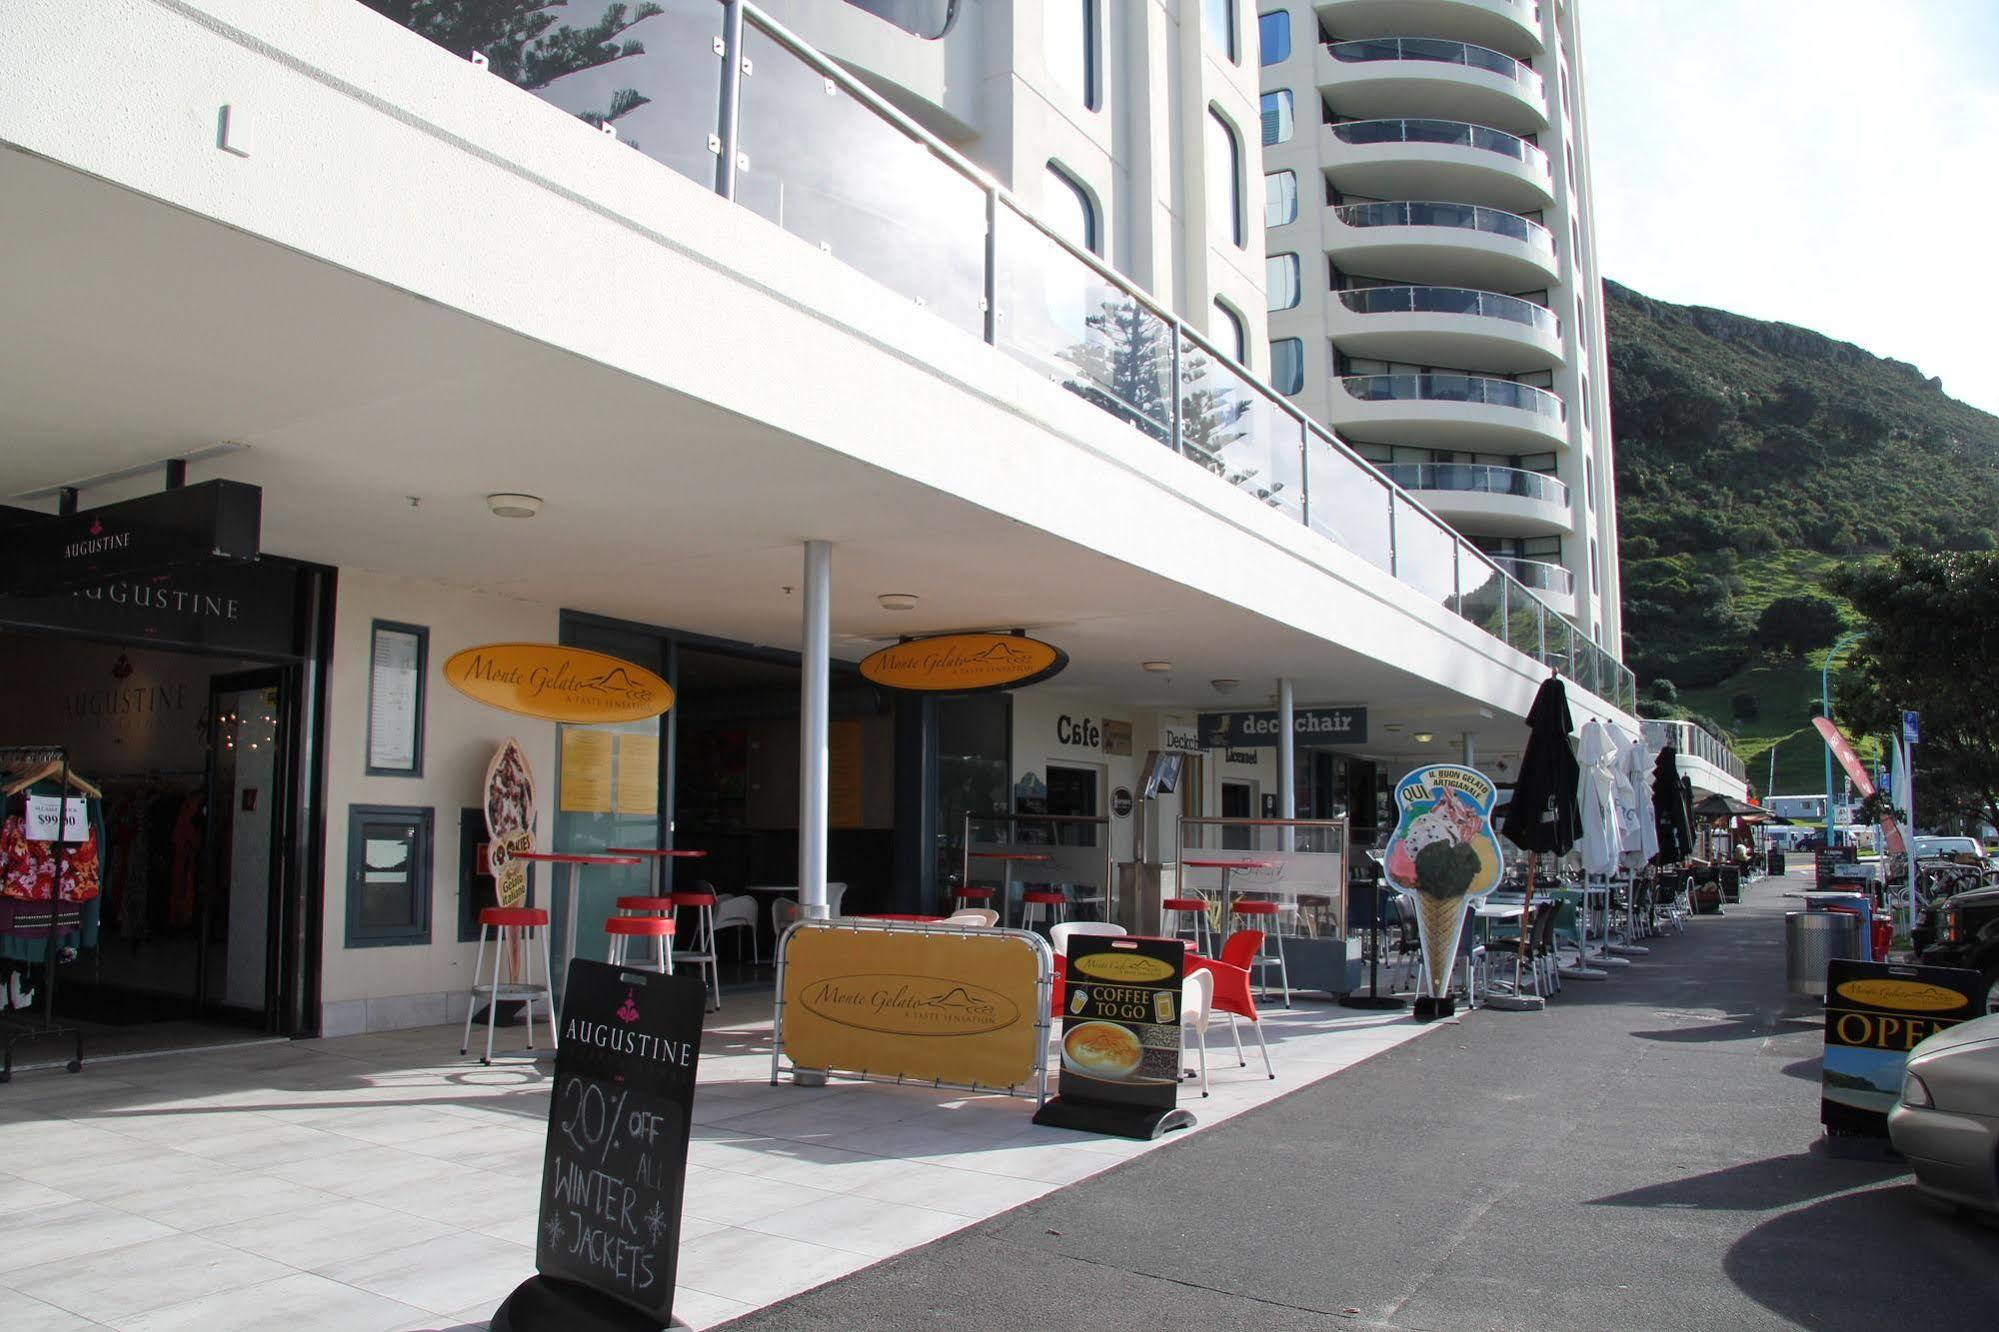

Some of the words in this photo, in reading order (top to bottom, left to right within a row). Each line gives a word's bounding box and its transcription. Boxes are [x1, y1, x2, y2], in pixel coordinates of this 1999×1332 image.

[64, 532, 131, 559] AUGUSTINE
[72, 583, 239, 620] UGUSTINE
[875, 654, 918, 672] Monte
[923, 645, 965, 675] Gelato
[463, 654, 523, 685] Monte
[529, 660, 582, 697] Gelato
[1243, 712, 1352, 735] decchair
[1402, 784, 1429, 802] QUI
[1429, 770, 1436, 778] IL
[1438, 770, 1460, 779] BUON
[1462, 773, 1488, 794] GELATO
[1433, 778, 1483, 799] ARTIGIANALE
[815, 983, 865, 1006] Monte
[870, 984, 921, 1015] Gelato
[1093, 986, 1150, 1004] COFFEE
[914, 1012, 940, 1023] TASTE
[943, 1012, 996, 1025] SENSATION
[1096, 1001, 1117, 1016] TO
[1121, 1004, 1145, 1019] GO
[566, 1017, 692, 1067] AUGUSTINE
[562, 1077, 628, 1165] 20%
[628, 1111, 665, 1145] OFF
[554, 1156, 638, 1236] WINTER
[568, 1211, 655, 1290] JACKETS
